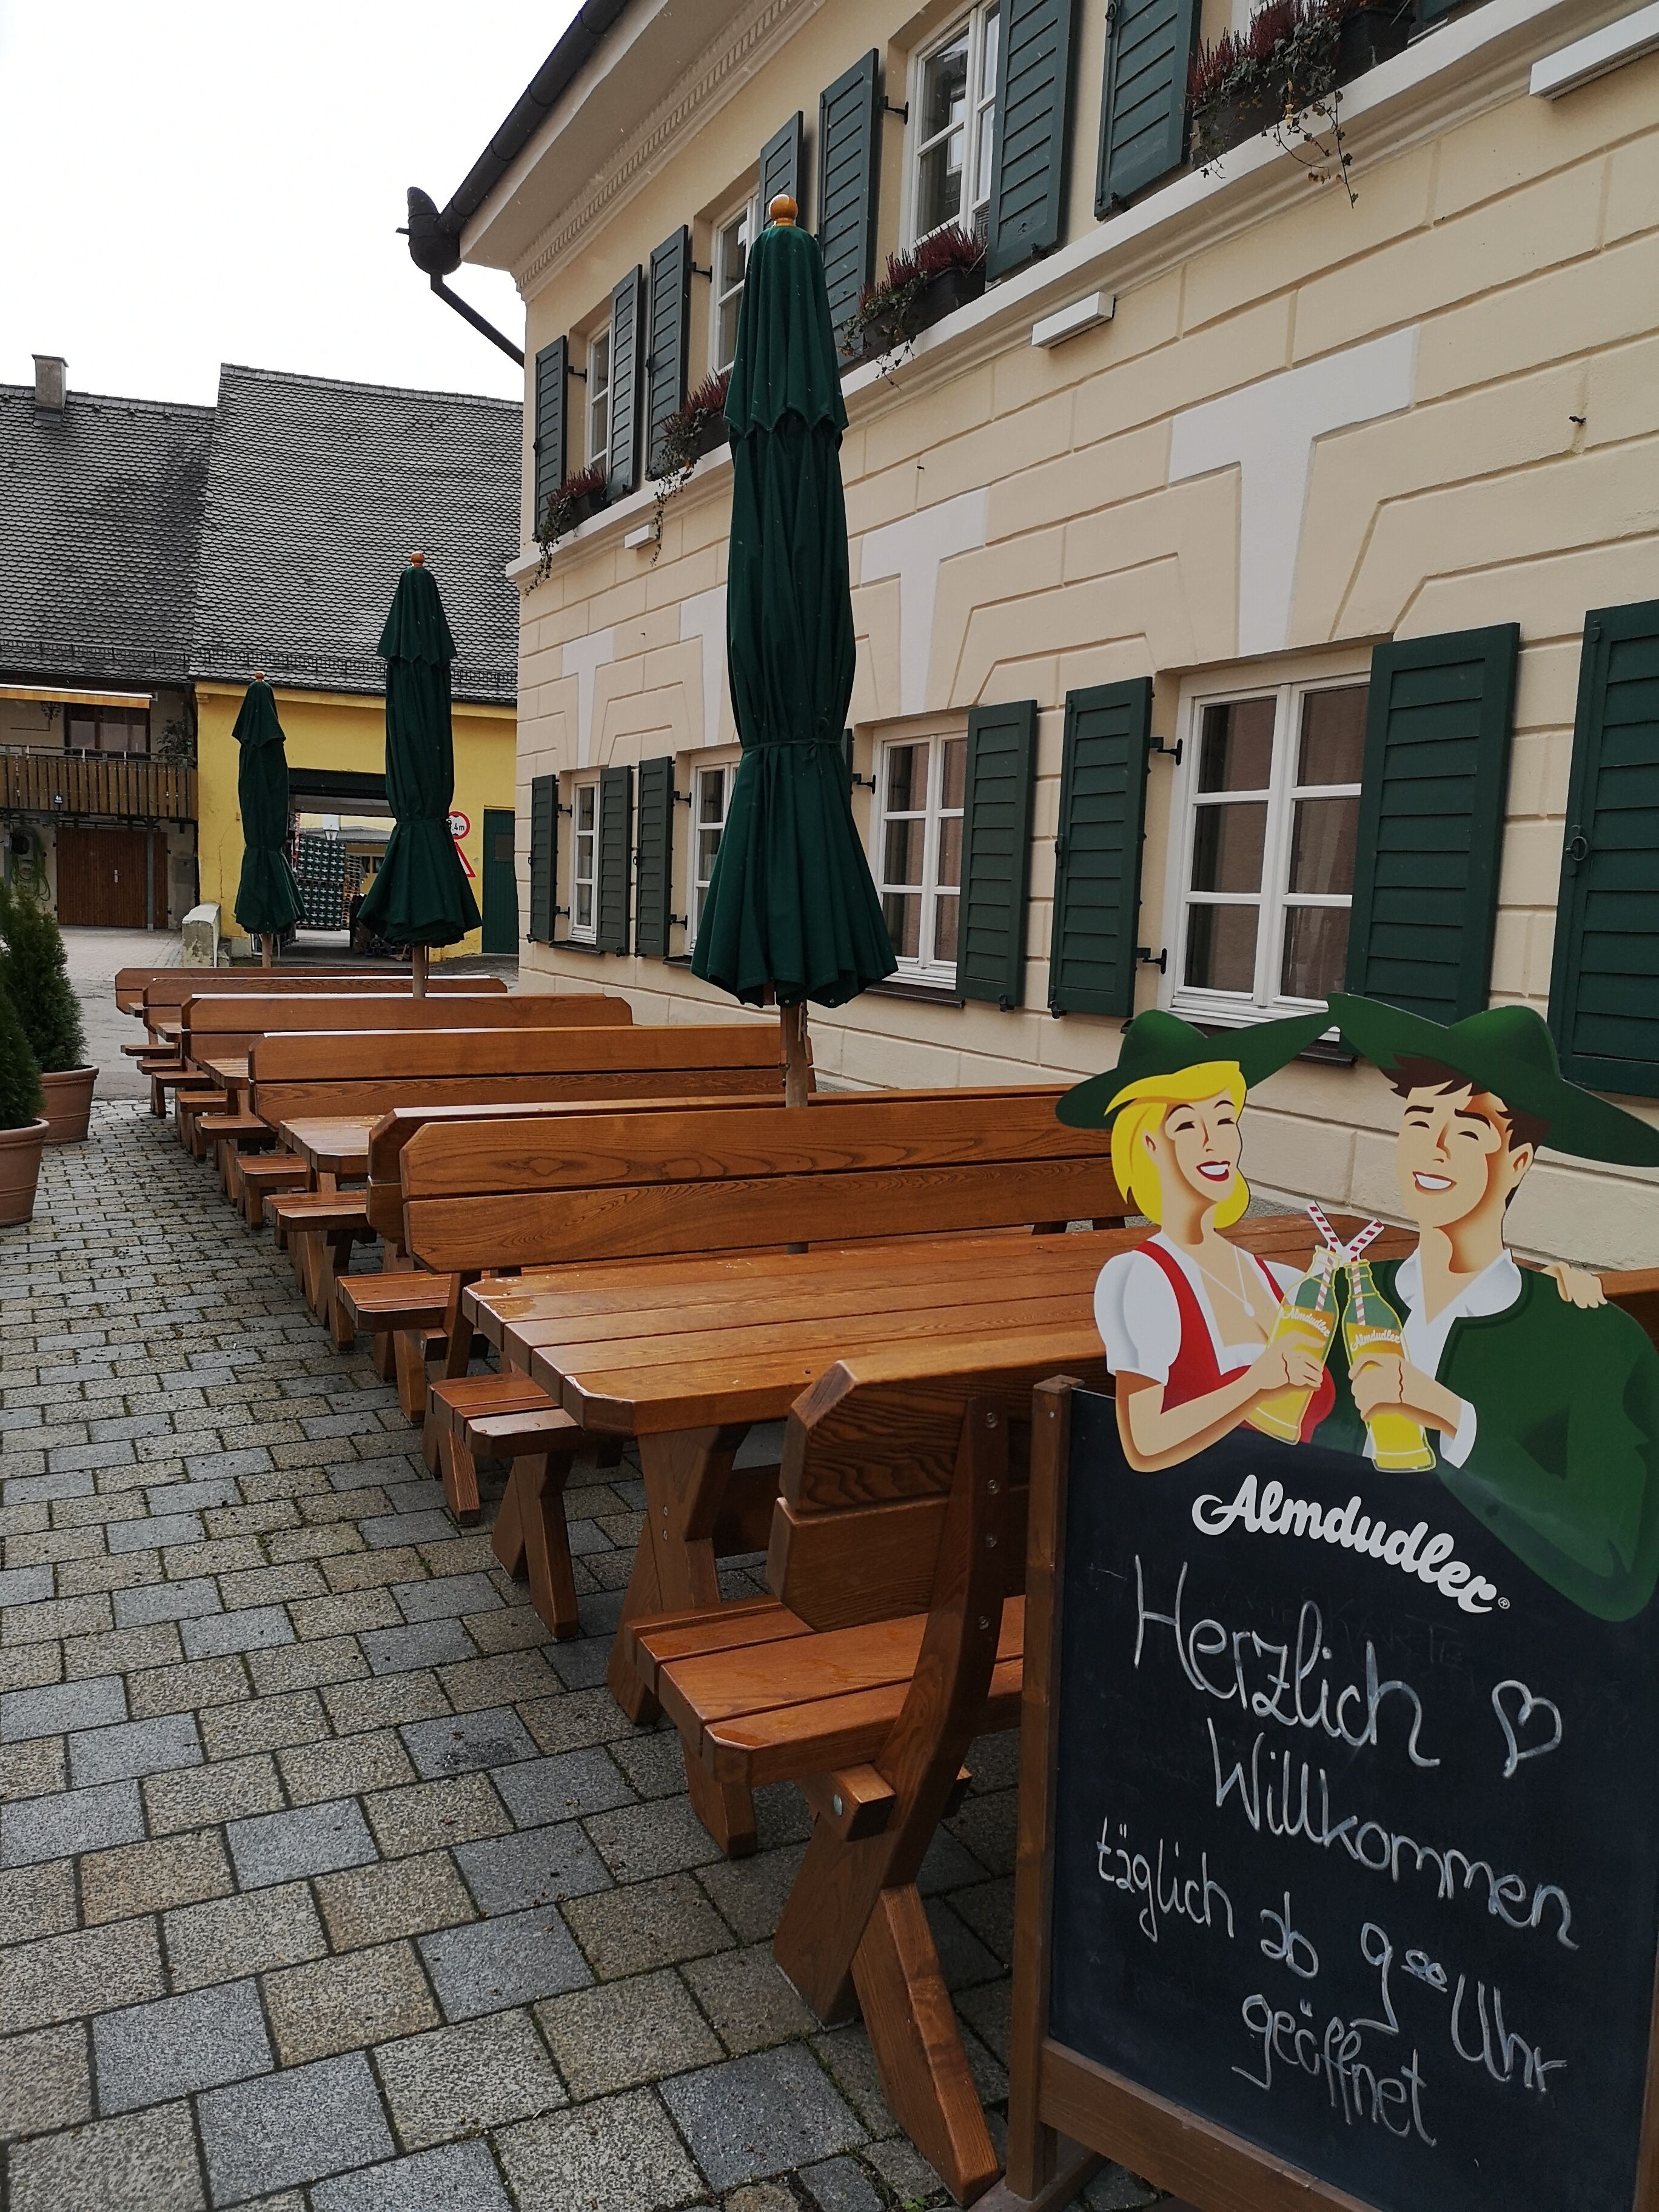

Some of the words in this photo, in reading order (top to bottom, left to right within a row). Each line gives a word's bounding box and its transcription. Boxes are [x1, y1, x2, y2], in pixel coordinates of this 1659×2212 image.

[1282, 1308, 1331, 1338] Almdudler
[1350, 1329, 1401, 1352] Almdudler
[1192, 1475, 1496, 1613] Almdudler
[1134, 1554, 1440, 1767] Herzlich
[1207, 1717, 1578, 1948] Willkommen
[1096, 1817, 1234, 1942] täglich
[1260, 1891, 1318, 1979] ab
[1451, 1973, 1568, 2094] Uhr
[1231, 1994, 1438, 2147] geöffnet
